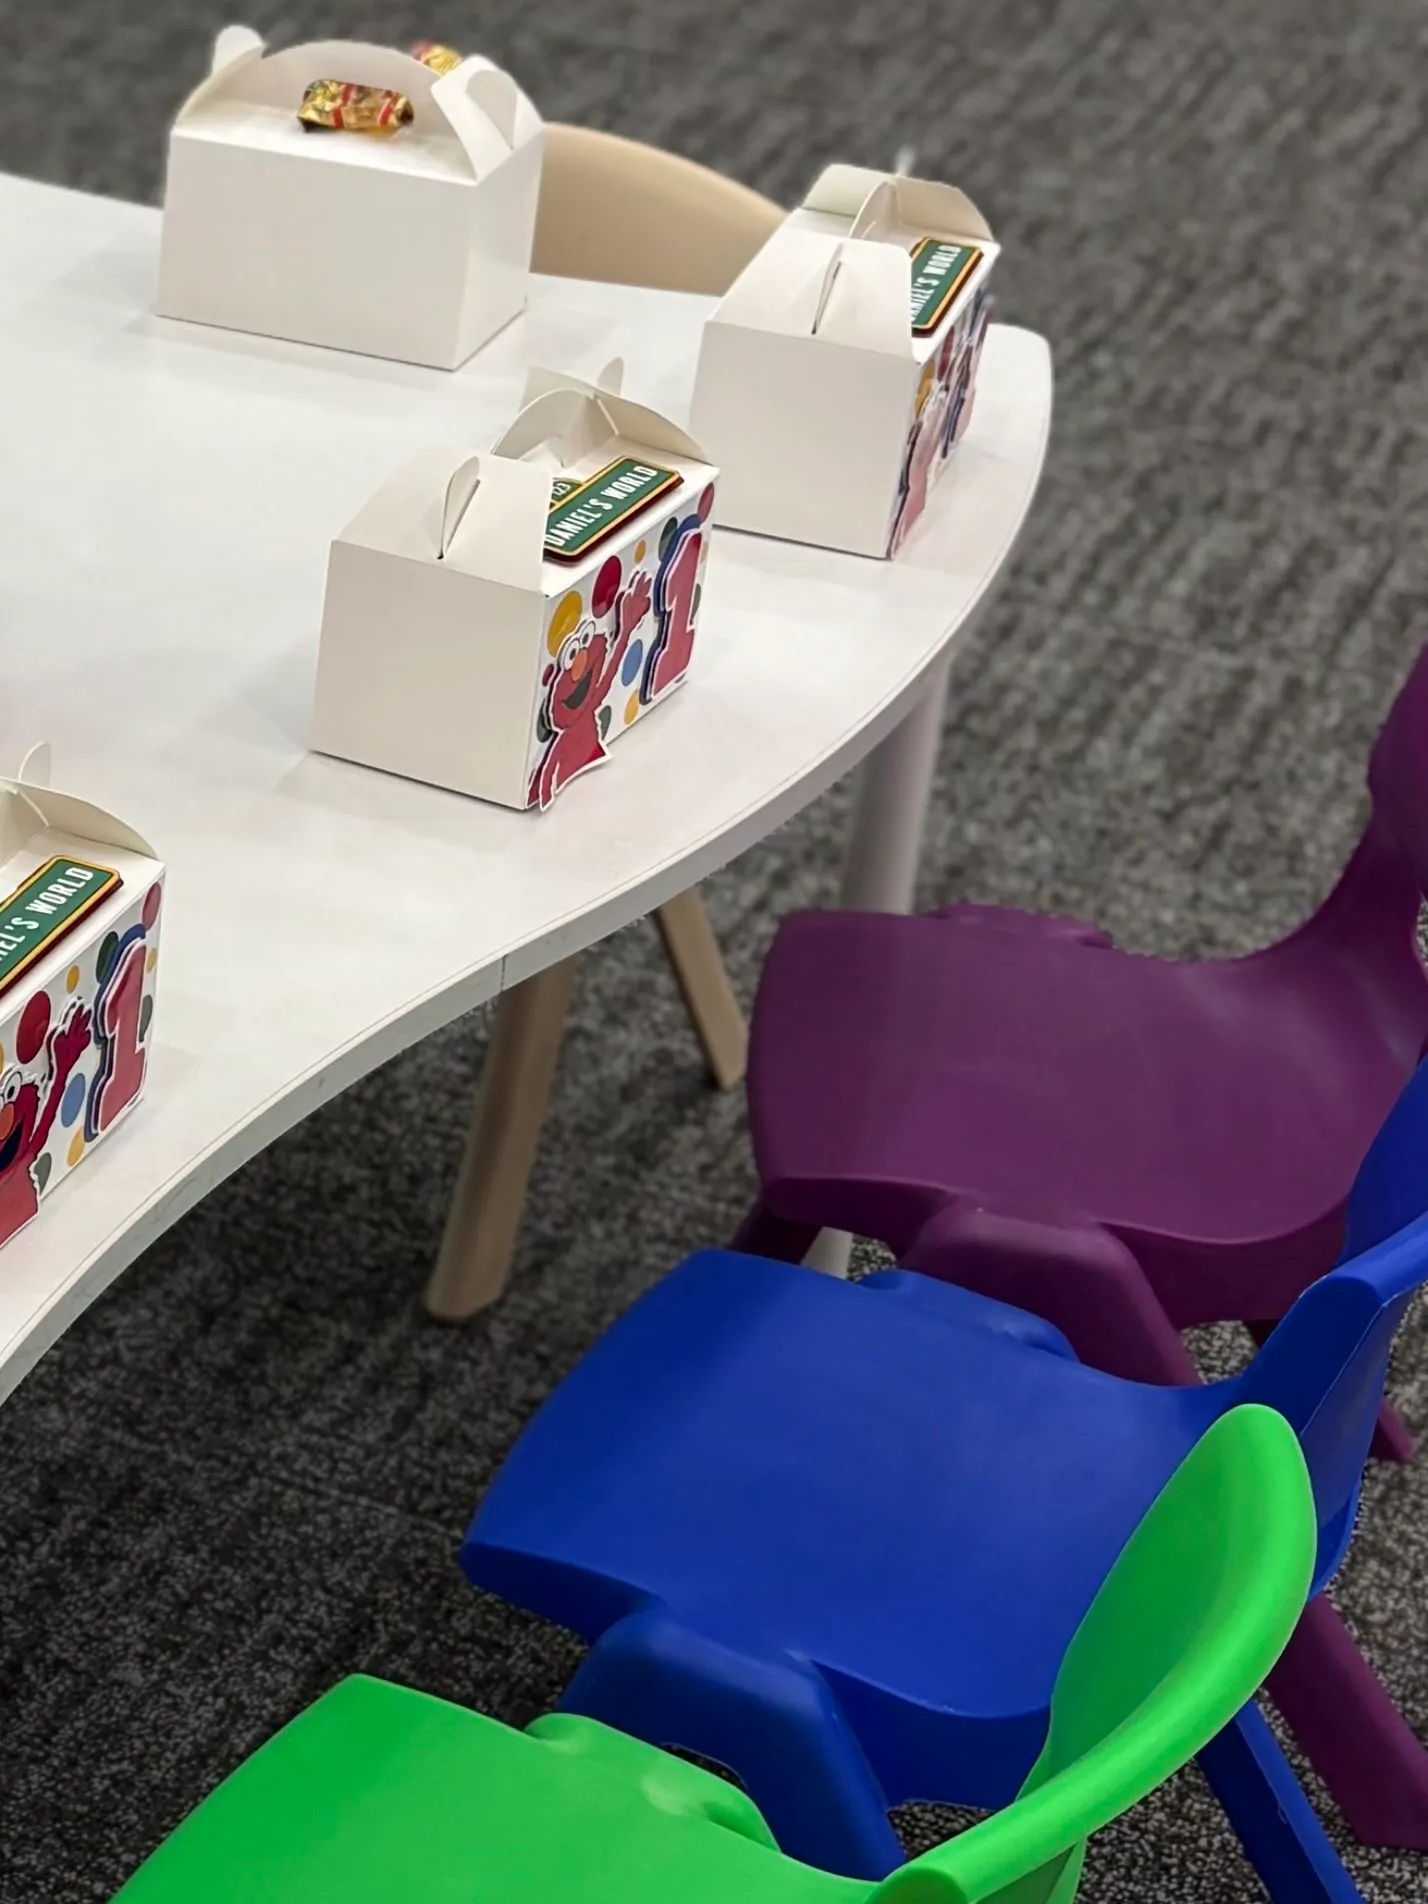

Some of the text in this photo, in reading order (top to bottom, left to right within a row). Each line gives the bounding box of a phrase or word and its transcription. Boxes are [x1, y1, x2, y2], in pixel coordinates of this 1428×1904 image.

[544, 465, 658, 547] DANIEL'S WORLD
[25, 866, 94, 915] WORLD
